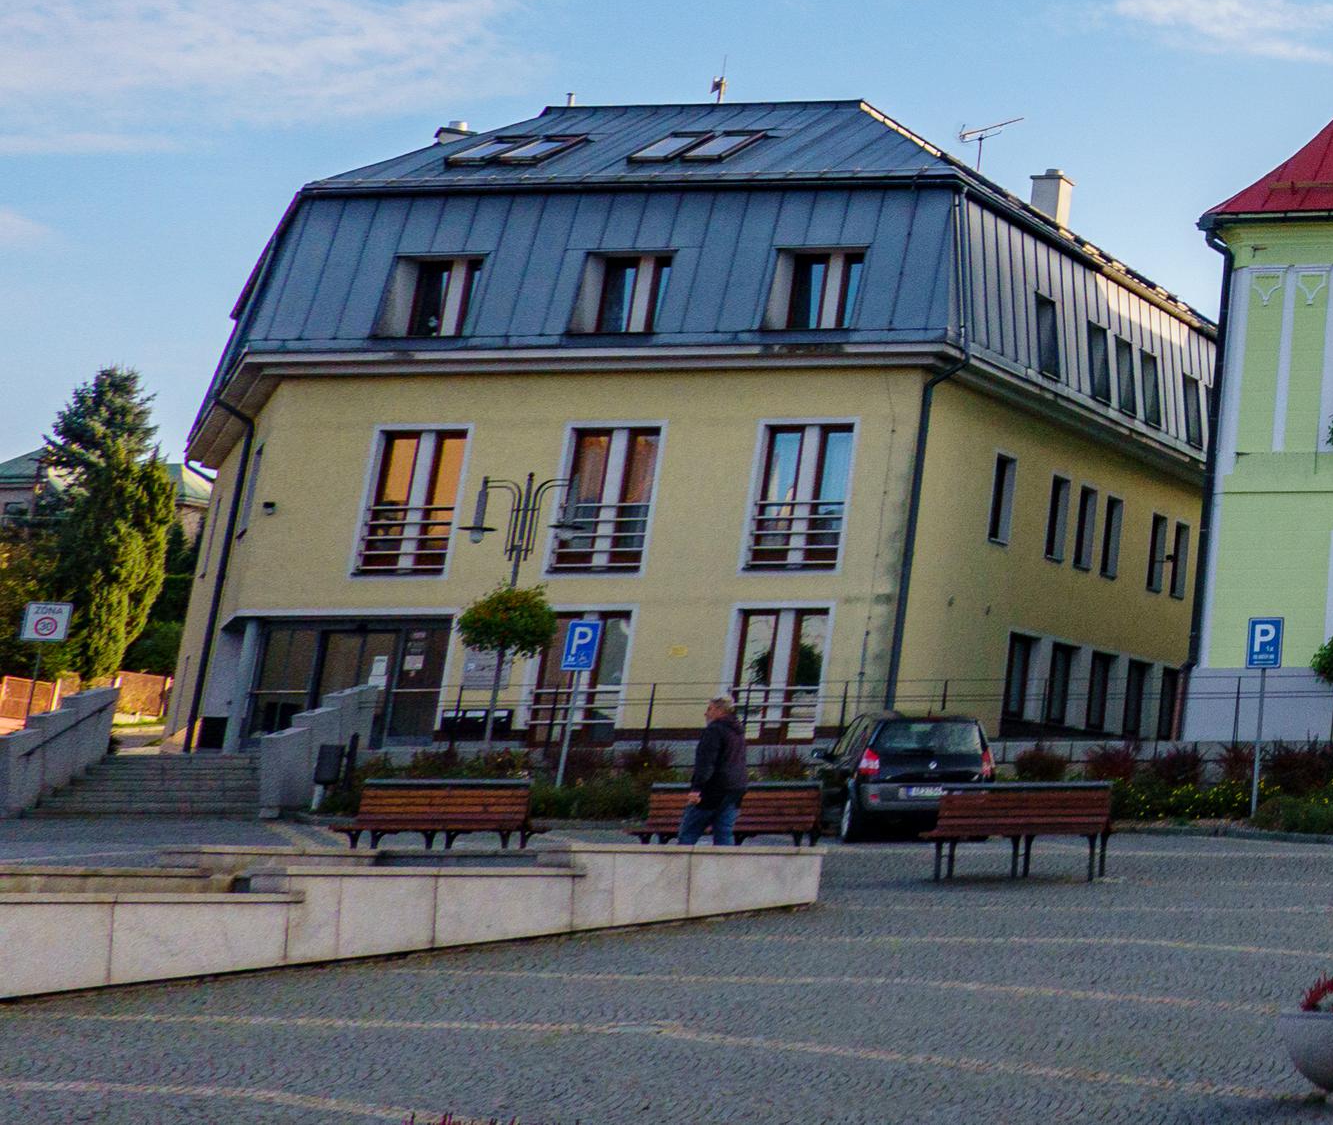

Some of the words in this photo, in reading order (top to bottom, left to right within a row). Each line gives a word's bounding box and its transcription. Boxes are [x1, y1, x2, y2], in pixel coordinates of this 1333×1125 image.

[34, 606, 63, 615] ZONA
[39, 622, 52, 631] 30
[570, 626, 593, 655] P
[1253, 624, 1276, 653] P
